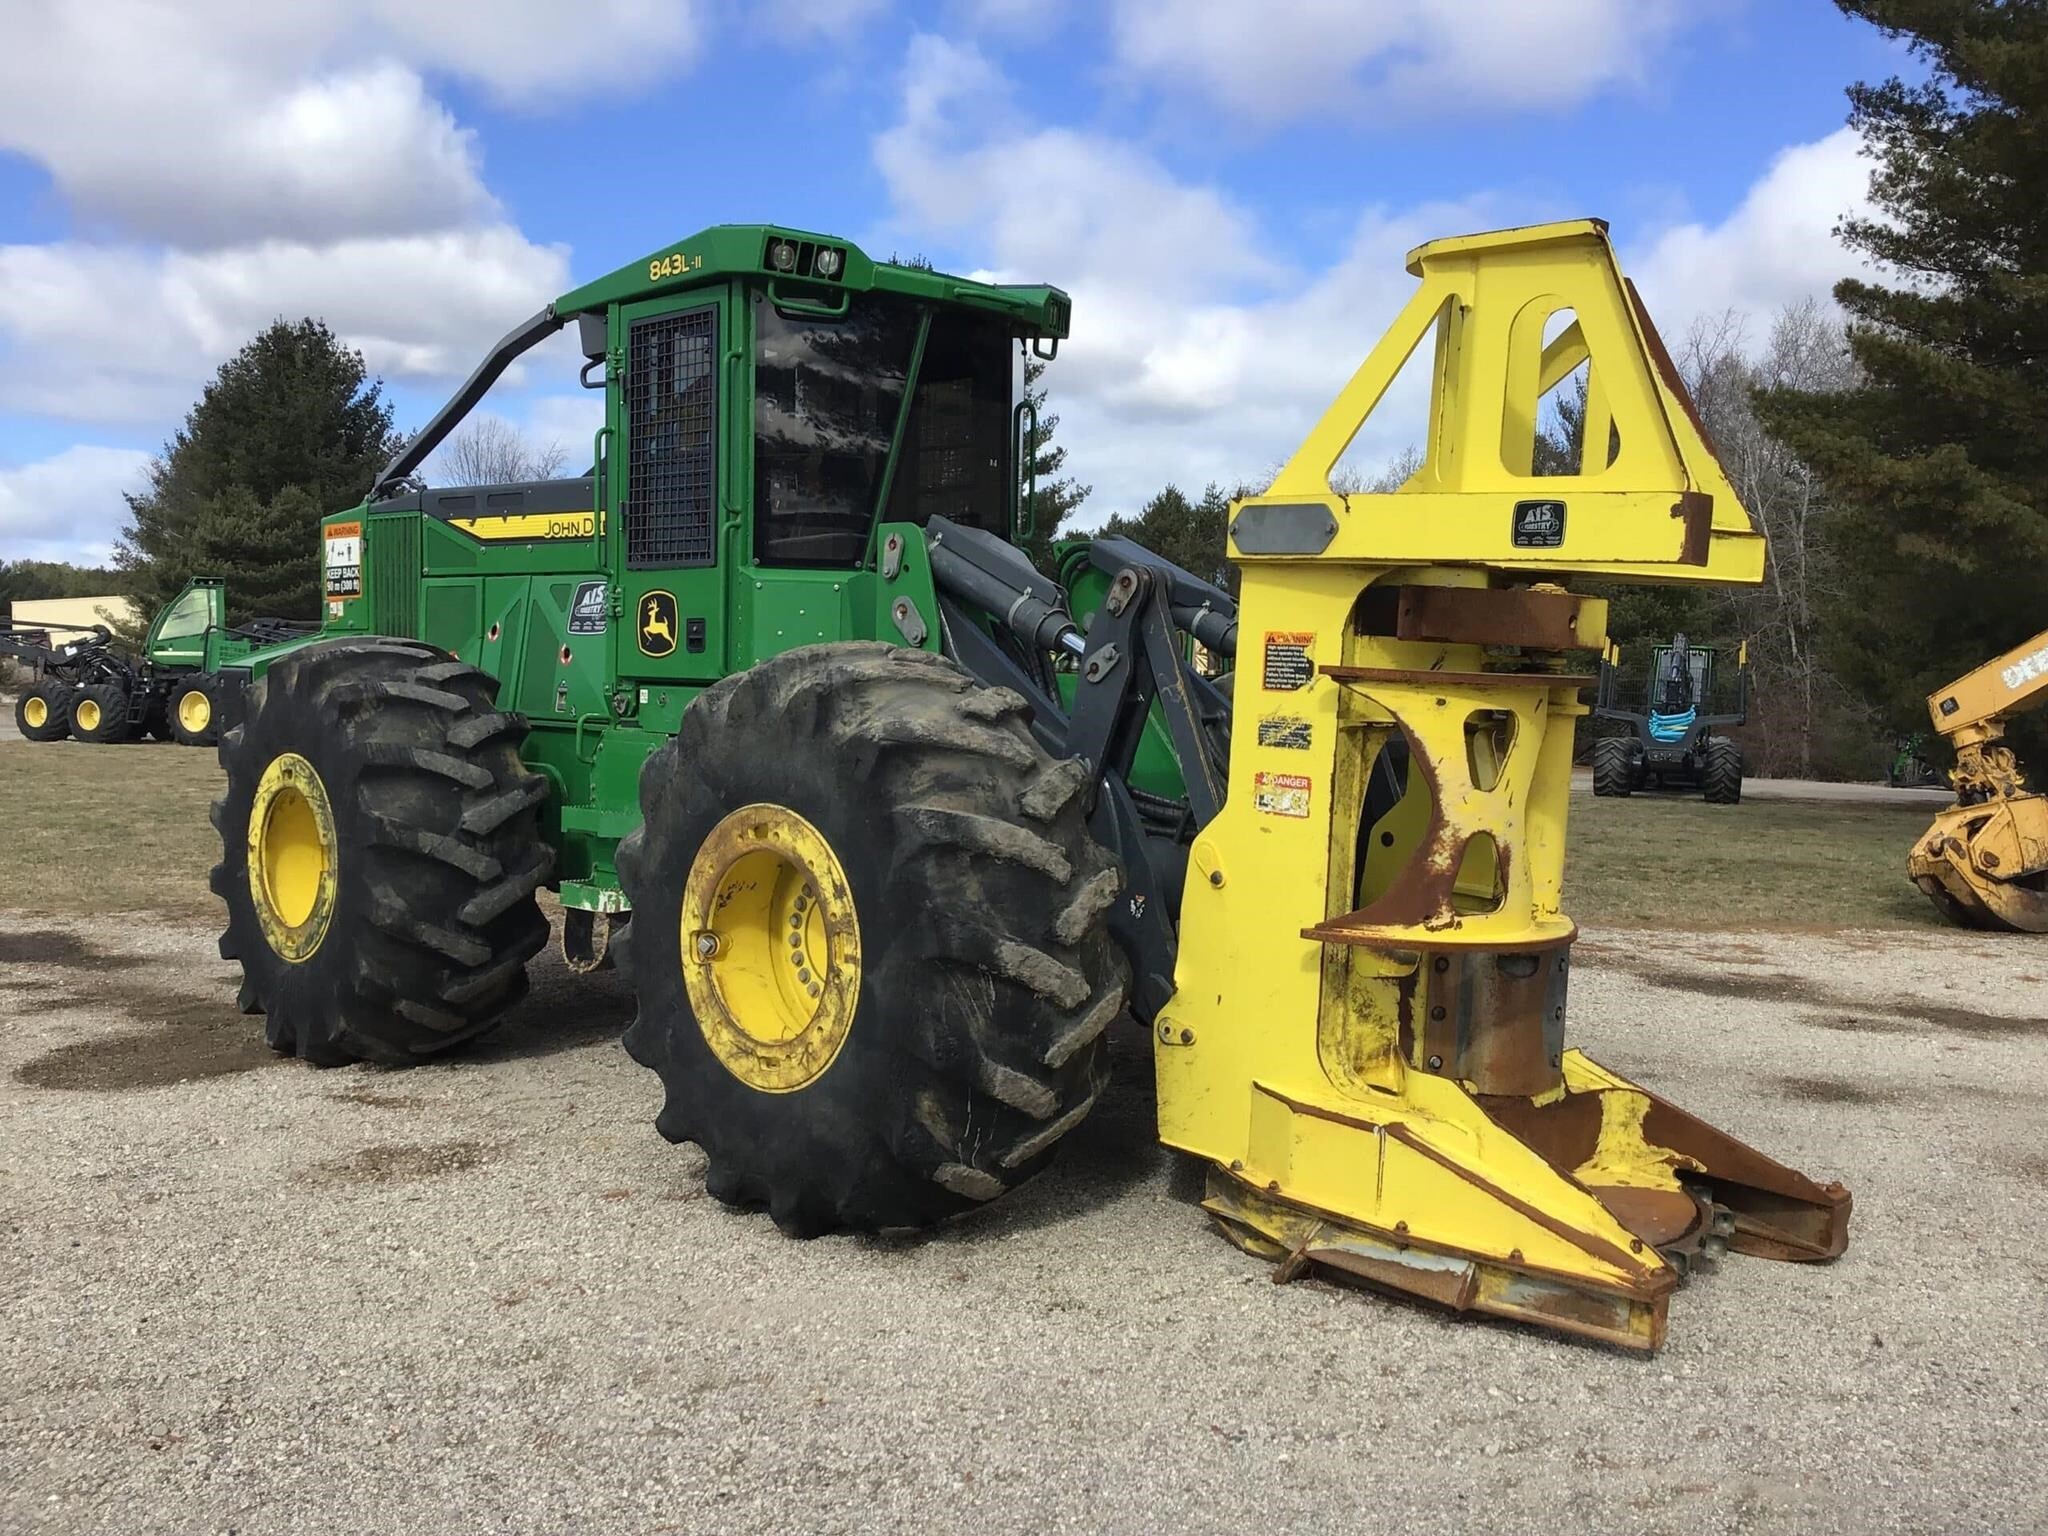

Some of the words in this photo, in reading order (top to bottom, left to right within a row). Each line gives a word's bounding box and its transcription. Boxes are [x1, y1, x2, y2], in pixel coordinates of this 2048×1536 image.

[1524, 504, 1553, 523] AIS
[333, 526, 359, 536] WARNING
[544, 519, 580, 536] JOHN
[327, 568, 341, 579] KEEP
[342, 567, 360, 578] BACK
[581, 585, 606, 606] AIS
[1271, 775, 1308, 788] DANGER
